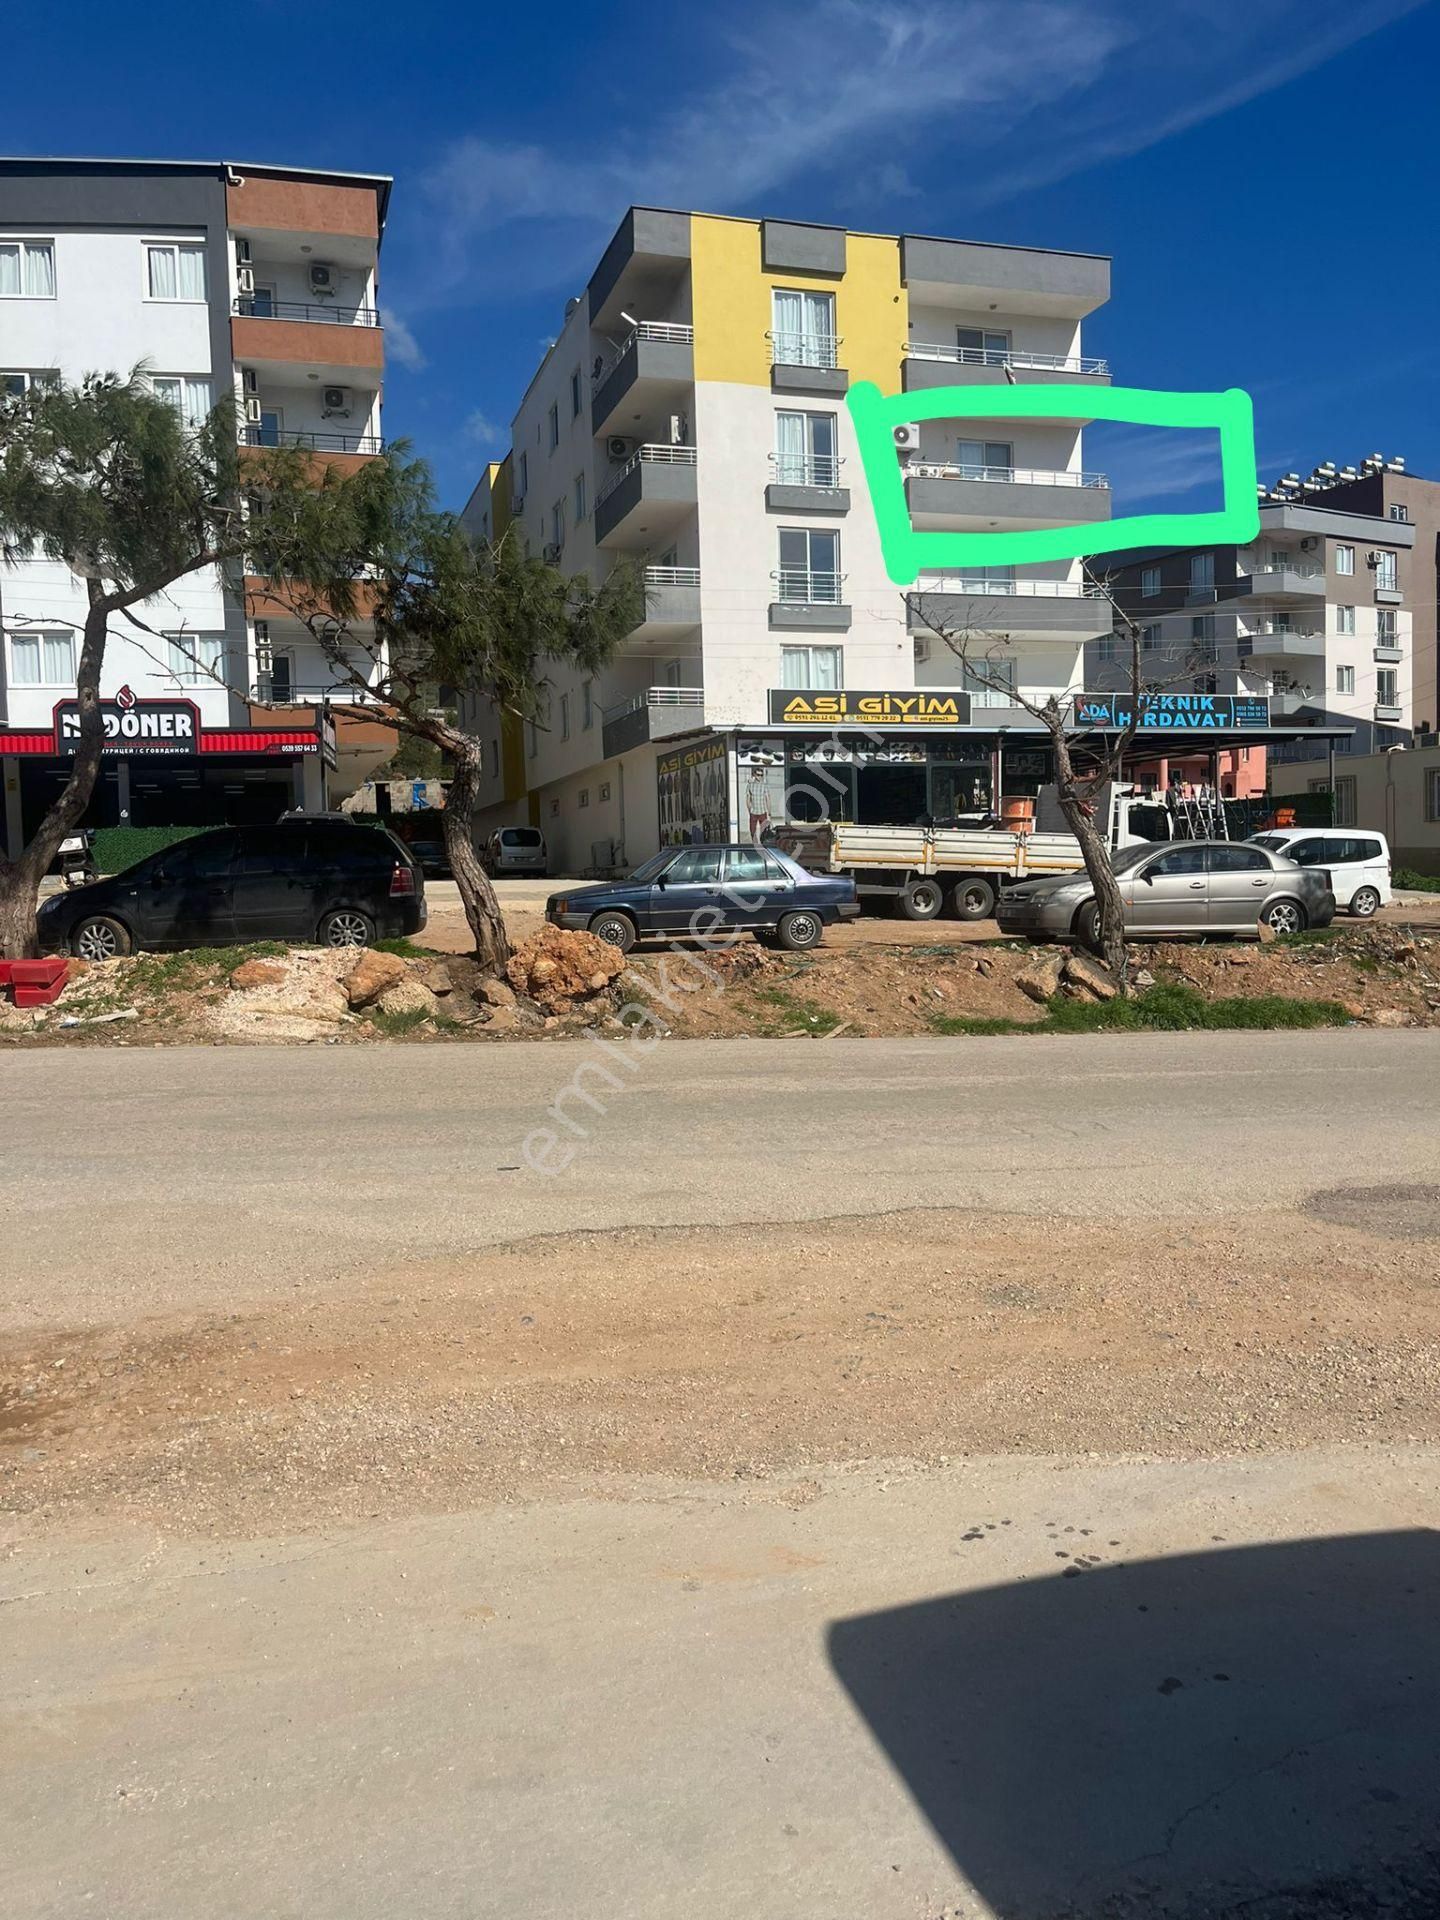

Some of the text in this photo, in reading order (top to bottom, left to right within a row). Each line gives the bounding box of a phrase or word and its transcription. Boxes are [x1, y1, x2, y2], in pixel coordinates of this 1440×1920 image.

[784, 693, 958, 714] ASİ GİYİM
[102, 709, 192, 738] DÖNER
[660, 743, 725, 775] ASİ GİYİM
